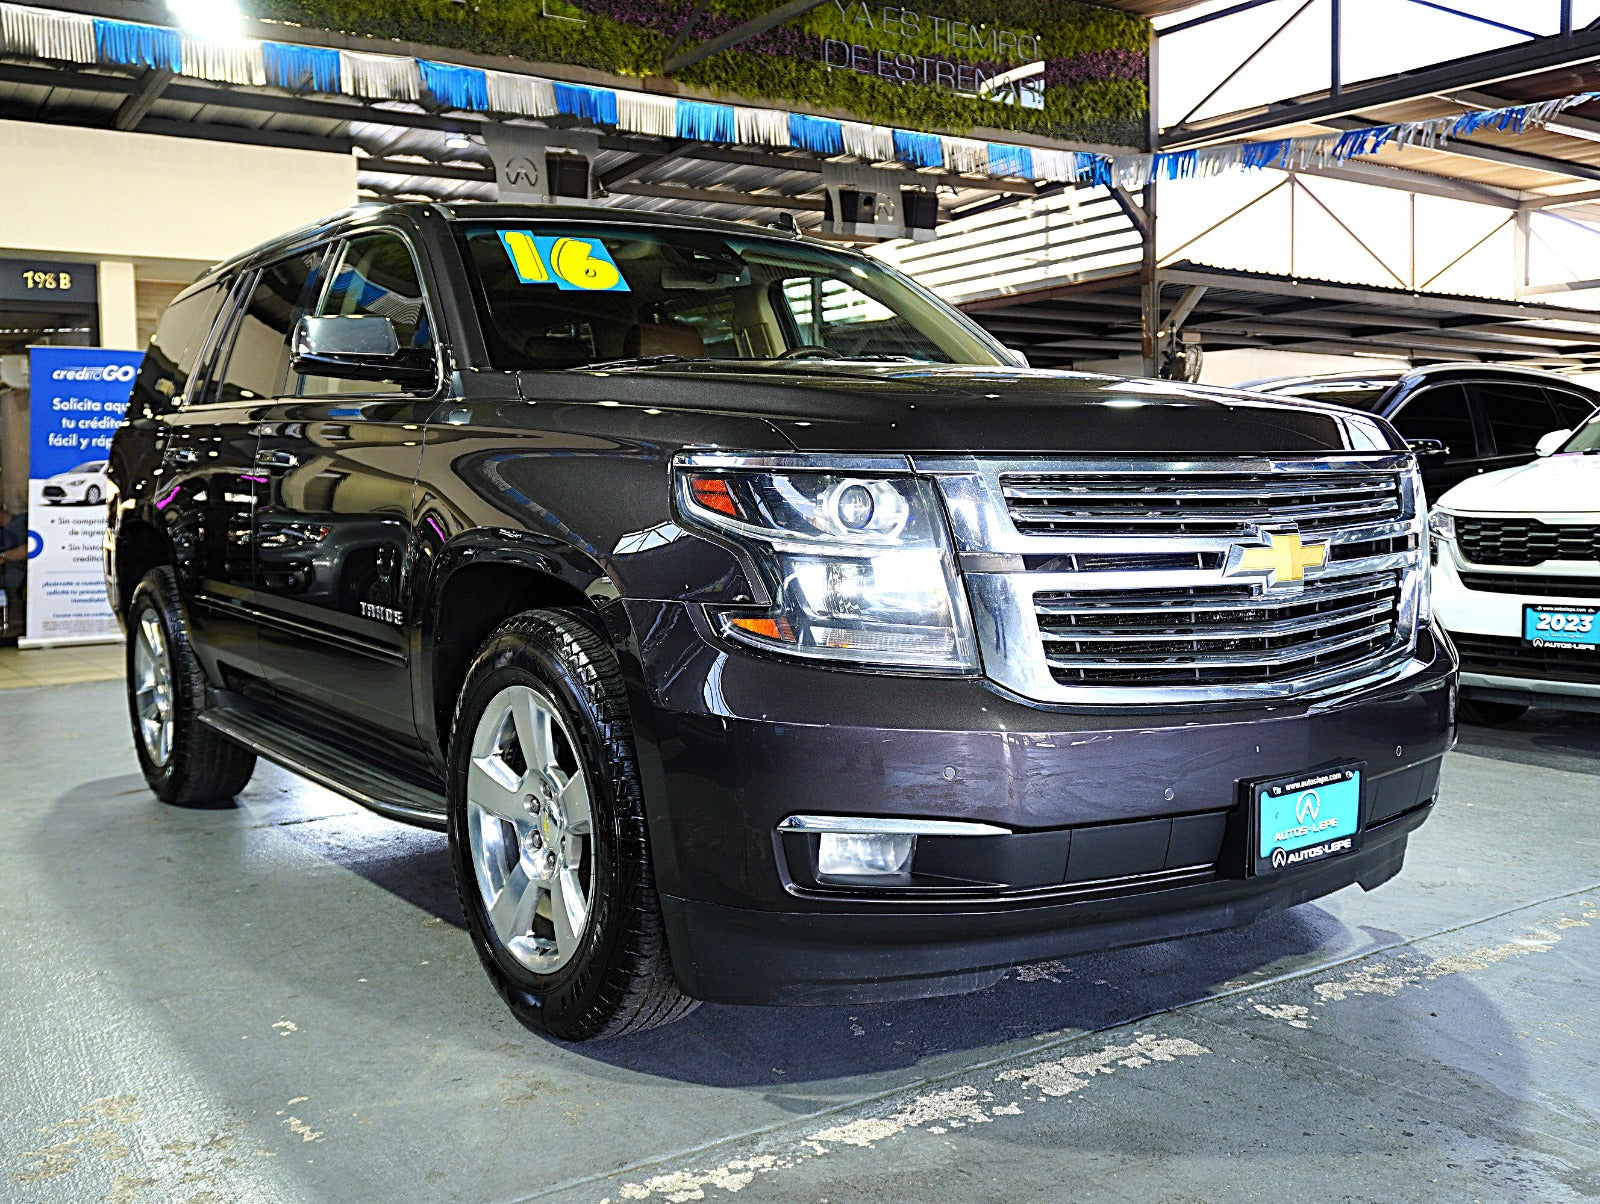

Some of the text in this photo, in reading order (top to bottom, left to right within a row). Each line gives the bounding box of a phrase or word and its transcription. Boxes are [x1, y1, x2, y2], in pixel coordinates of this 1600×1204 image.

[835, 0, 1038, 62] YA ES TIEMPO
[824, 38, 870, 74] DE
[504, 231, 620, 290] 16
[22, 270, 72, 290] 198 B
[52, 397, 128, 415] Solicita aqu
[62, 417, 77, 429] tu
[48, 432, 113, 450] fácil y ráp
[72, 517, 108, 526] comprob
[69, 528, 105, 538] de ingres
[359, 601, 404, 625] TAHOE
[1536, 612, 1595, 634] 2023
[1285, 772, 1342, 791] www.autoslepe.com
